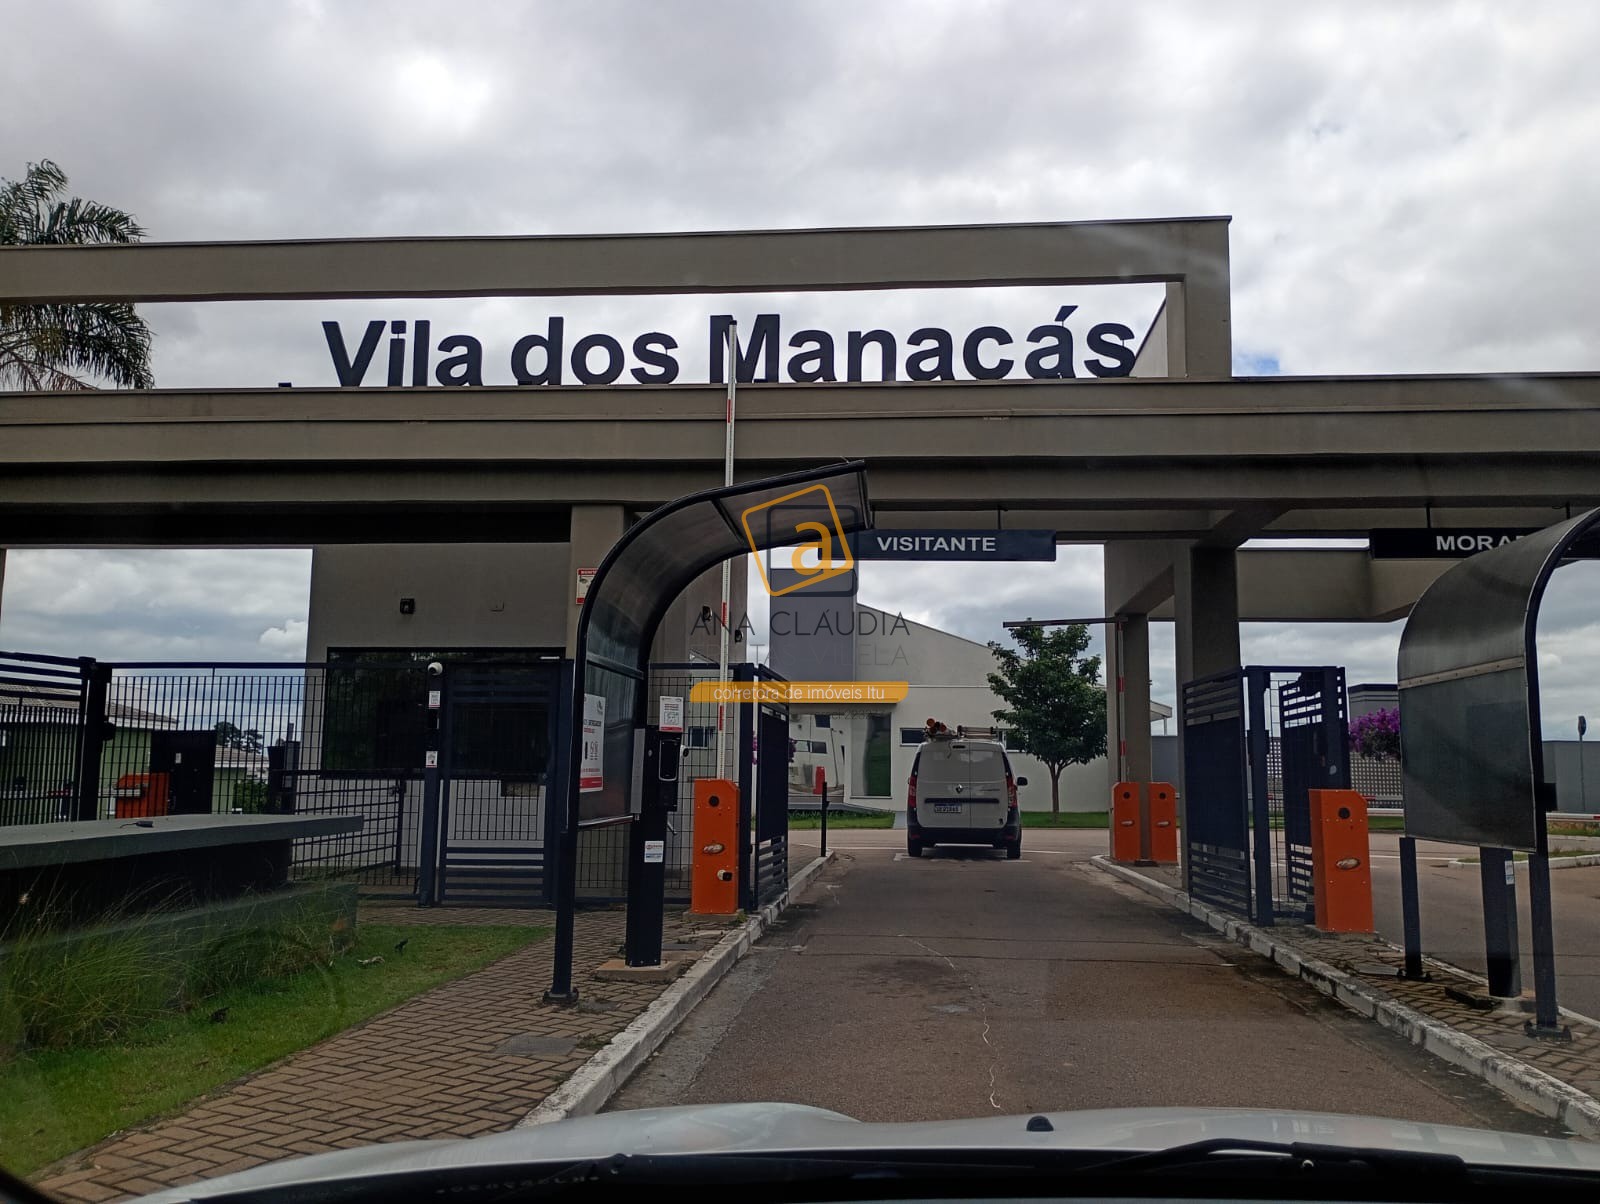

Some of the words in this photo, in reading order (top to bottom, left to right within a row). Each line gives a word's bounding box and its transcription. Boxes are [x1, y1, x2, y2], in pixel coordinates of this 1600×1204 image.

[321, 320, 483, 387] Vila
[511, 316, 680, 386] dos
[709, 305, 1137, 383] Manacás
[877, 536, 997, 552] VISITANTE
[1436, 535, 1525, 551] MORA
